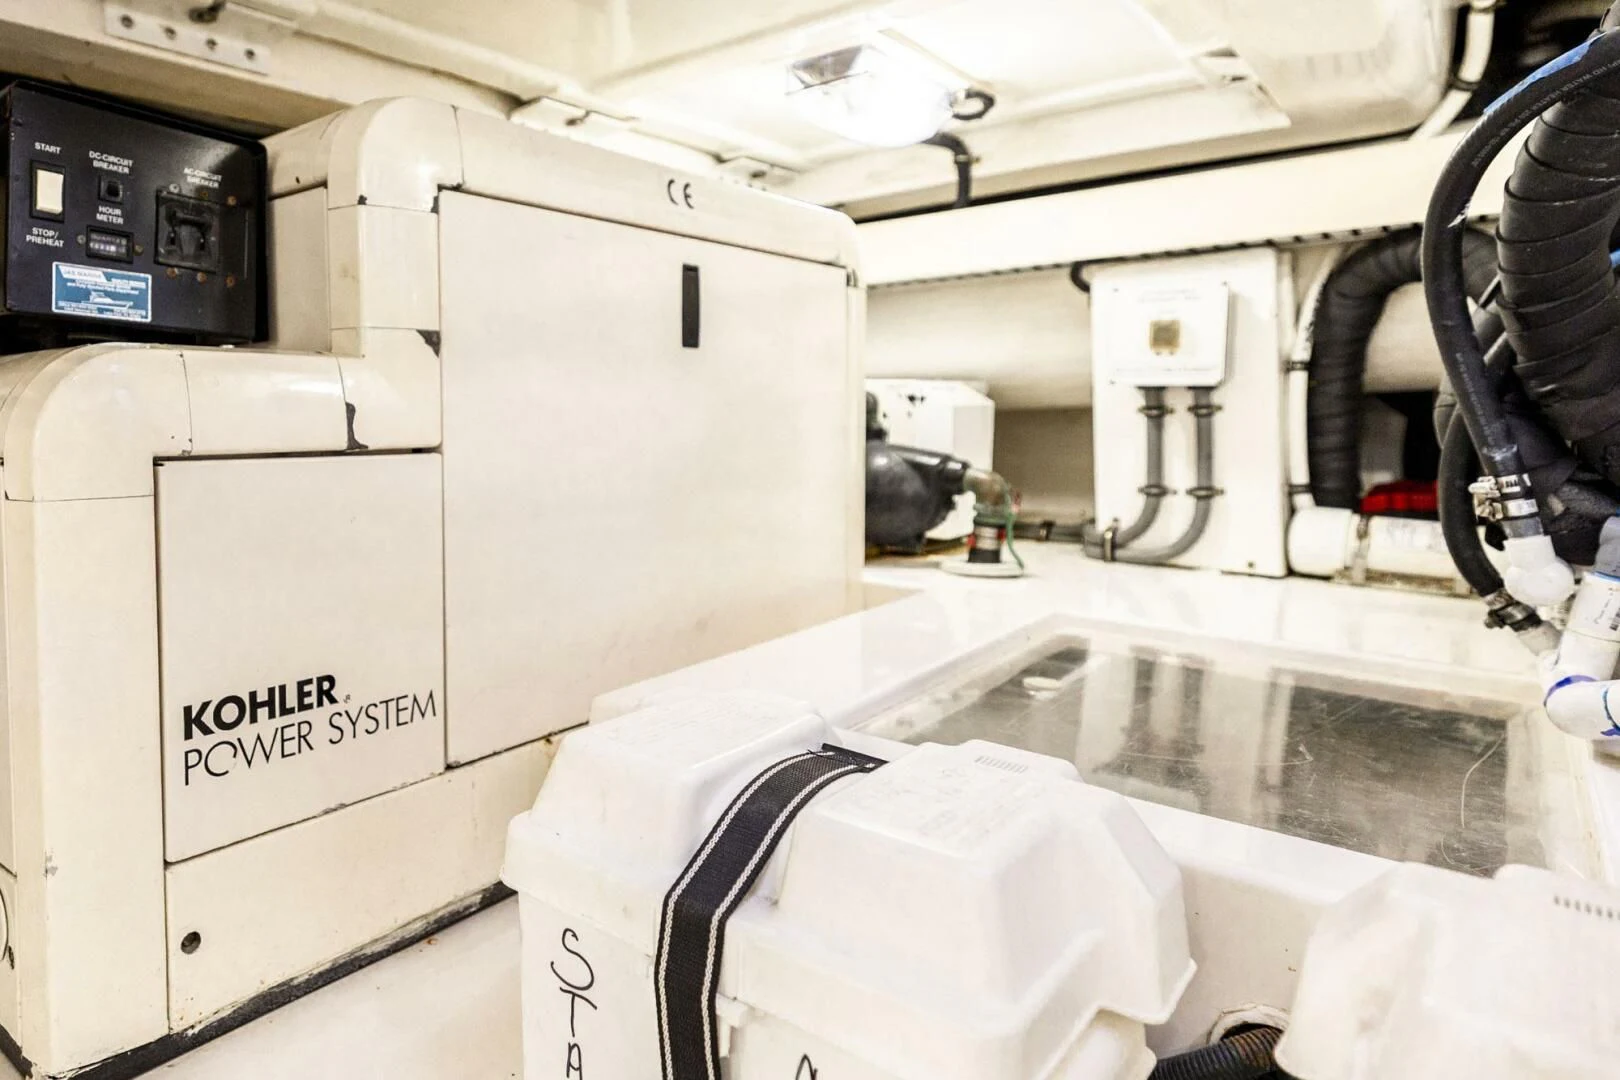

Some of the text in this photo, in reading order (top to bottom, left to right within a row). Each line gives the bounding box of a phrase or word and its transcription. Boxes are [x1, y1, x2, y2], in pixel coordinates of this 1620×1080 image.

[34, 142, 61, 154] START
[93, 160, 129, 174] BREAKER
[187, 175, 219, 188] BREAKER
[667, 178, 694, 209] CE
[98, 205, 121, 216] HOUR
[96, 213, 123, 224] METER
[32, 227, 59, 239] STOP/
[26, 234, 64, 247] PREHEAT
[183, 674, 338, 741] KOHLER
[184, 689, 437, 786] POWER SYSTEM
